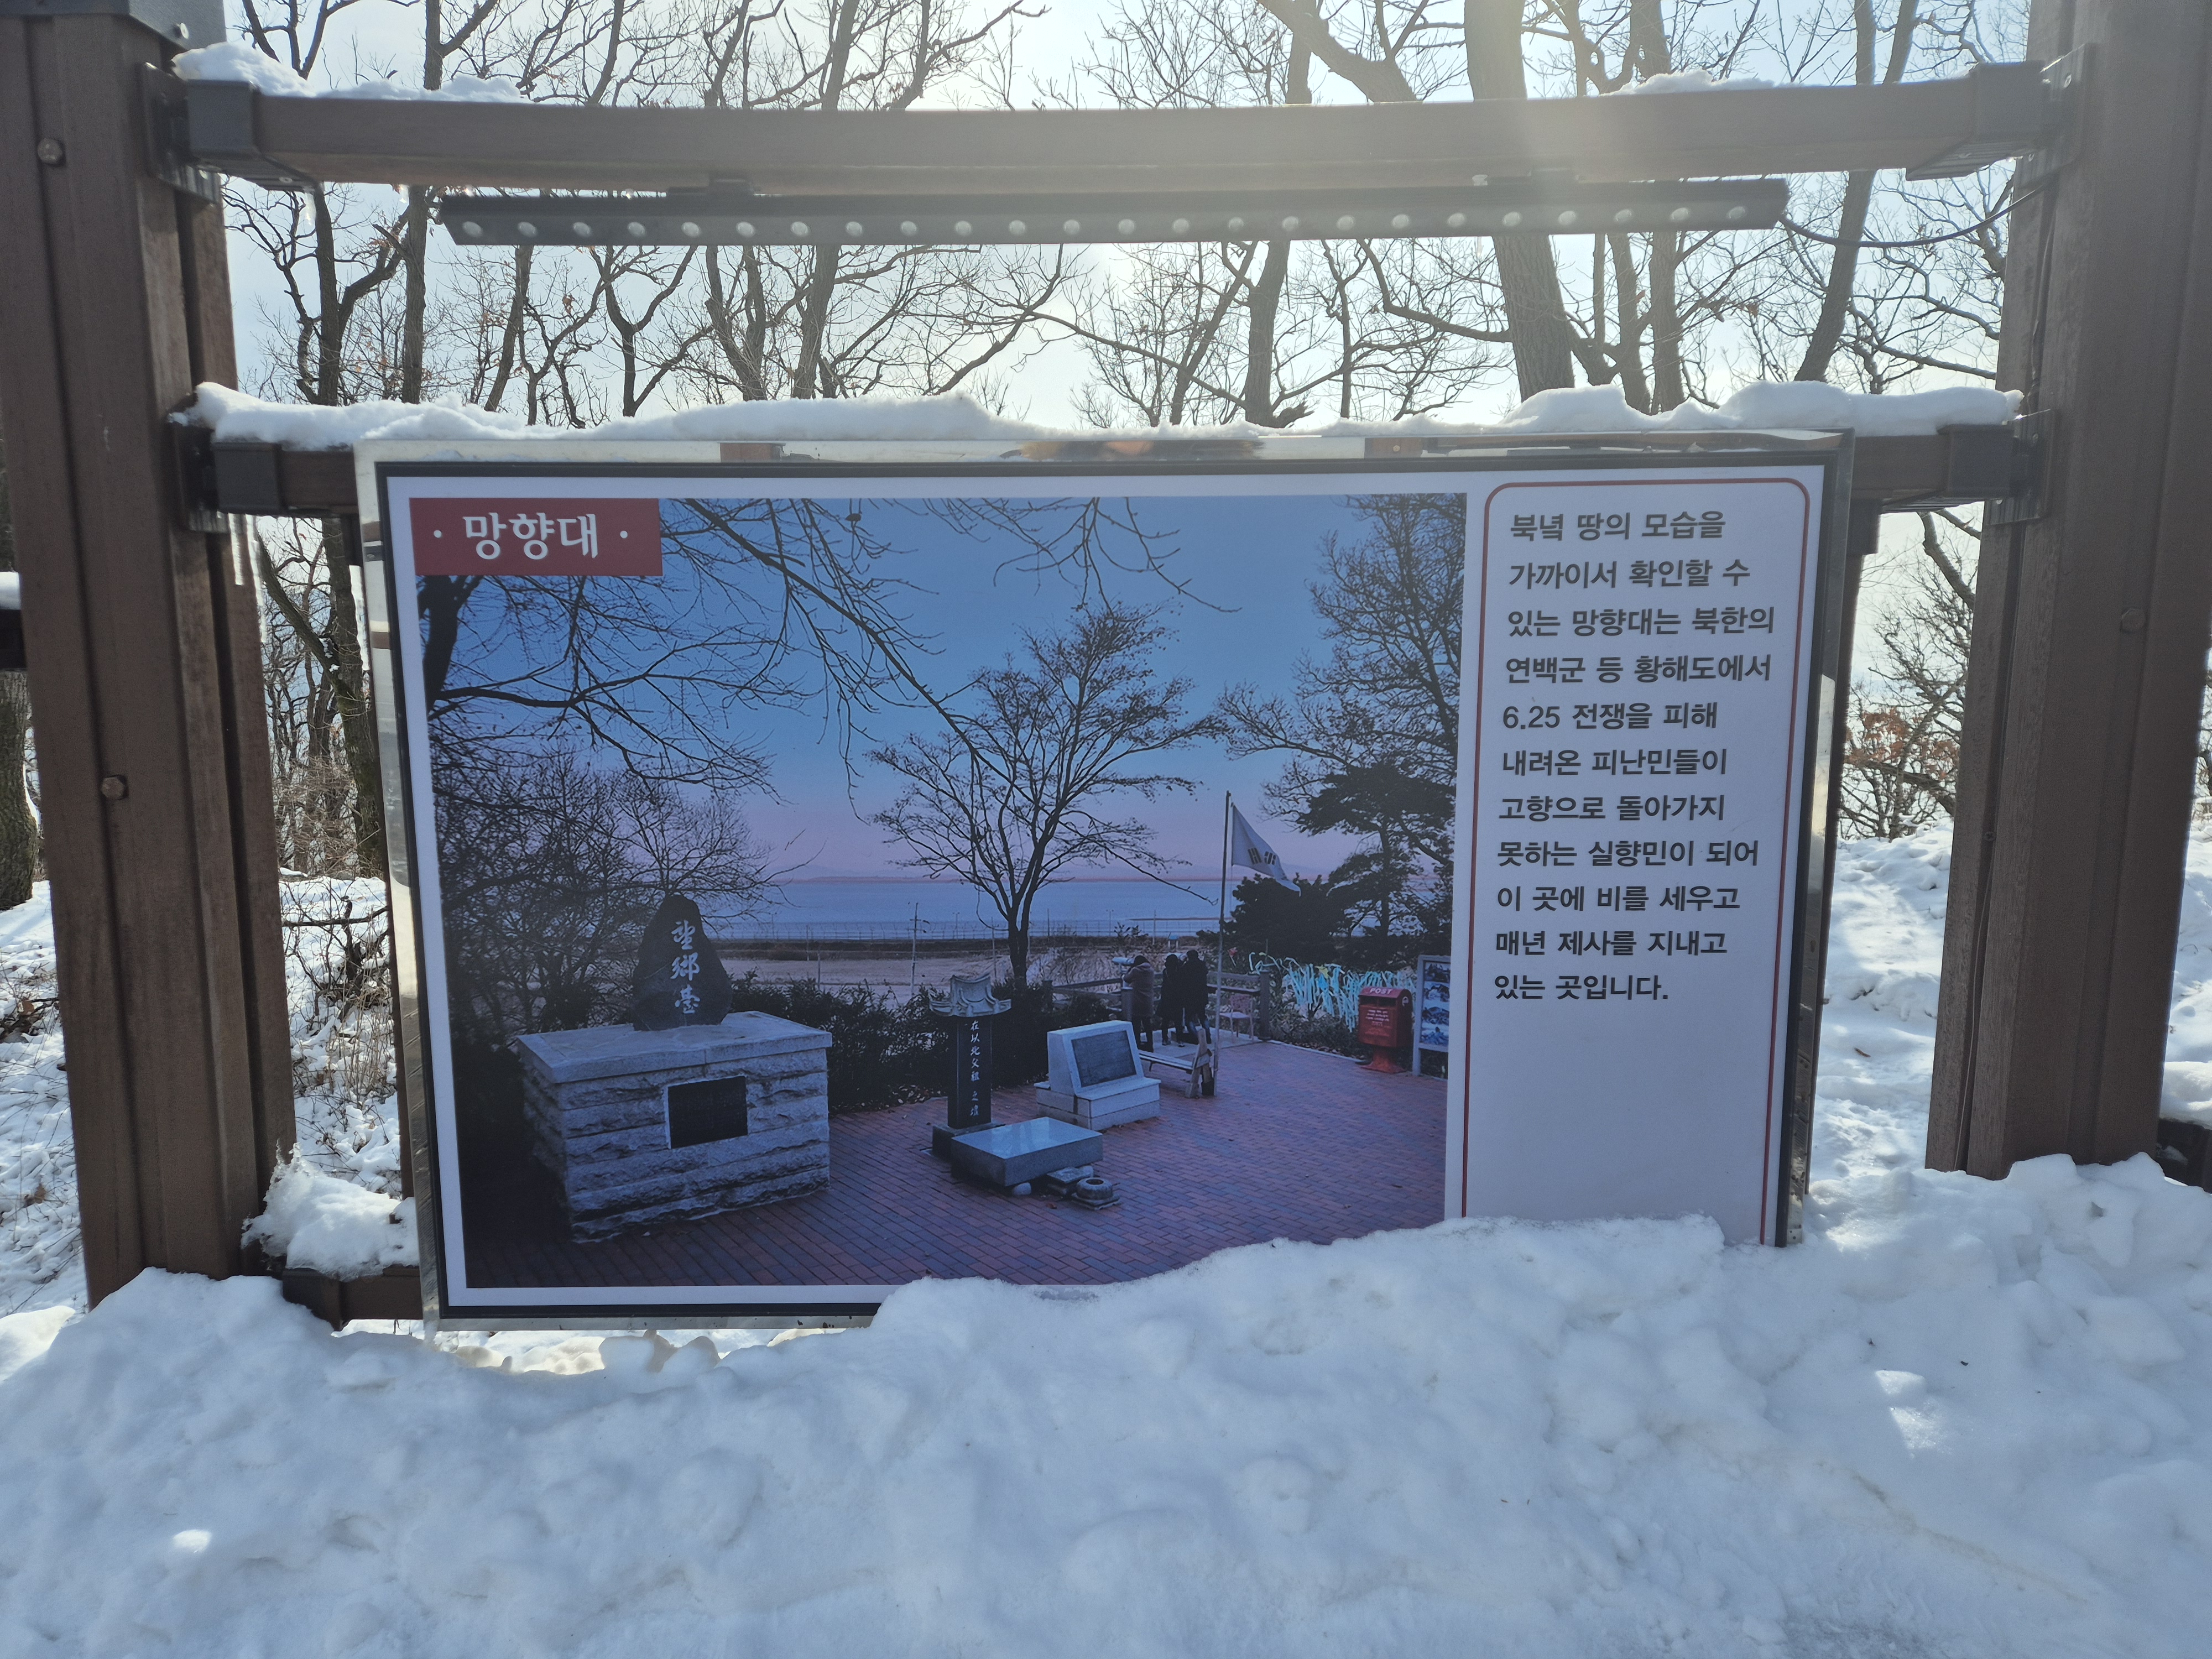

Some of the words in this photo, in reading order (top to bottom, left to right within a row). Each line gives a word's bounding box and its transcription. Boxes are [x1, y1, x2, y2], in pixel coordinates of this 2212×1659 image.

[462, 512, 598, 560] 망향대
[1510, 514, 1564, 541] 북녘
[1577, 512, 1630, 541] 땅의
[1641, 510, 1726, 539] 모습을
[1509, 561, 1617, 589] 가까이서
[1629, 559, 1713, 588] 확인할
[1723, 559, 1750, 587] 수
[1508, 610, 1561, 637] 있는
[1573, 608, 1682, 637] 망향대는
[1692, 607, 1775, 634] 북한의
[1506, 657, 1586, 684] 연백군
[1596, 656, 1624, 684] 등
[1634, 654, 1771, 683] 황해도에서
[1503, 706, 1560, 730] 6.25
[1572, 702, 1653, 730] 전쟁을
[1663, 702, 1718, 729] 피해
[1503, 749, 1581, 776] 내려온
[1592, 748, 1727, 776] 피난민들이
[1499, 795, 1606, 822] 고향으로
[1616, 794, 1725, 821] 돌아가지
[1498, 841, 1577, 867] 못하는
[1588, 841, 1694, 867] 실향민이
[1706, 840, 1759, 866] 되어
[1498, 886, 1521, 911] 이
[1532, 886, 1584, 911] 곳에
[1597, 886, 1649, 911] 비를
[1659, 885, 1740, 911] 세우고
[1496, 930, 1545, 956] 매년
[1557, 930, 1637, 956] 제사를
[1647, 930, 1728, 956] 지내고
[1494, 974, 1546, 999] 있는
[1556, 975, 1668, 1000] 곳입니다.
